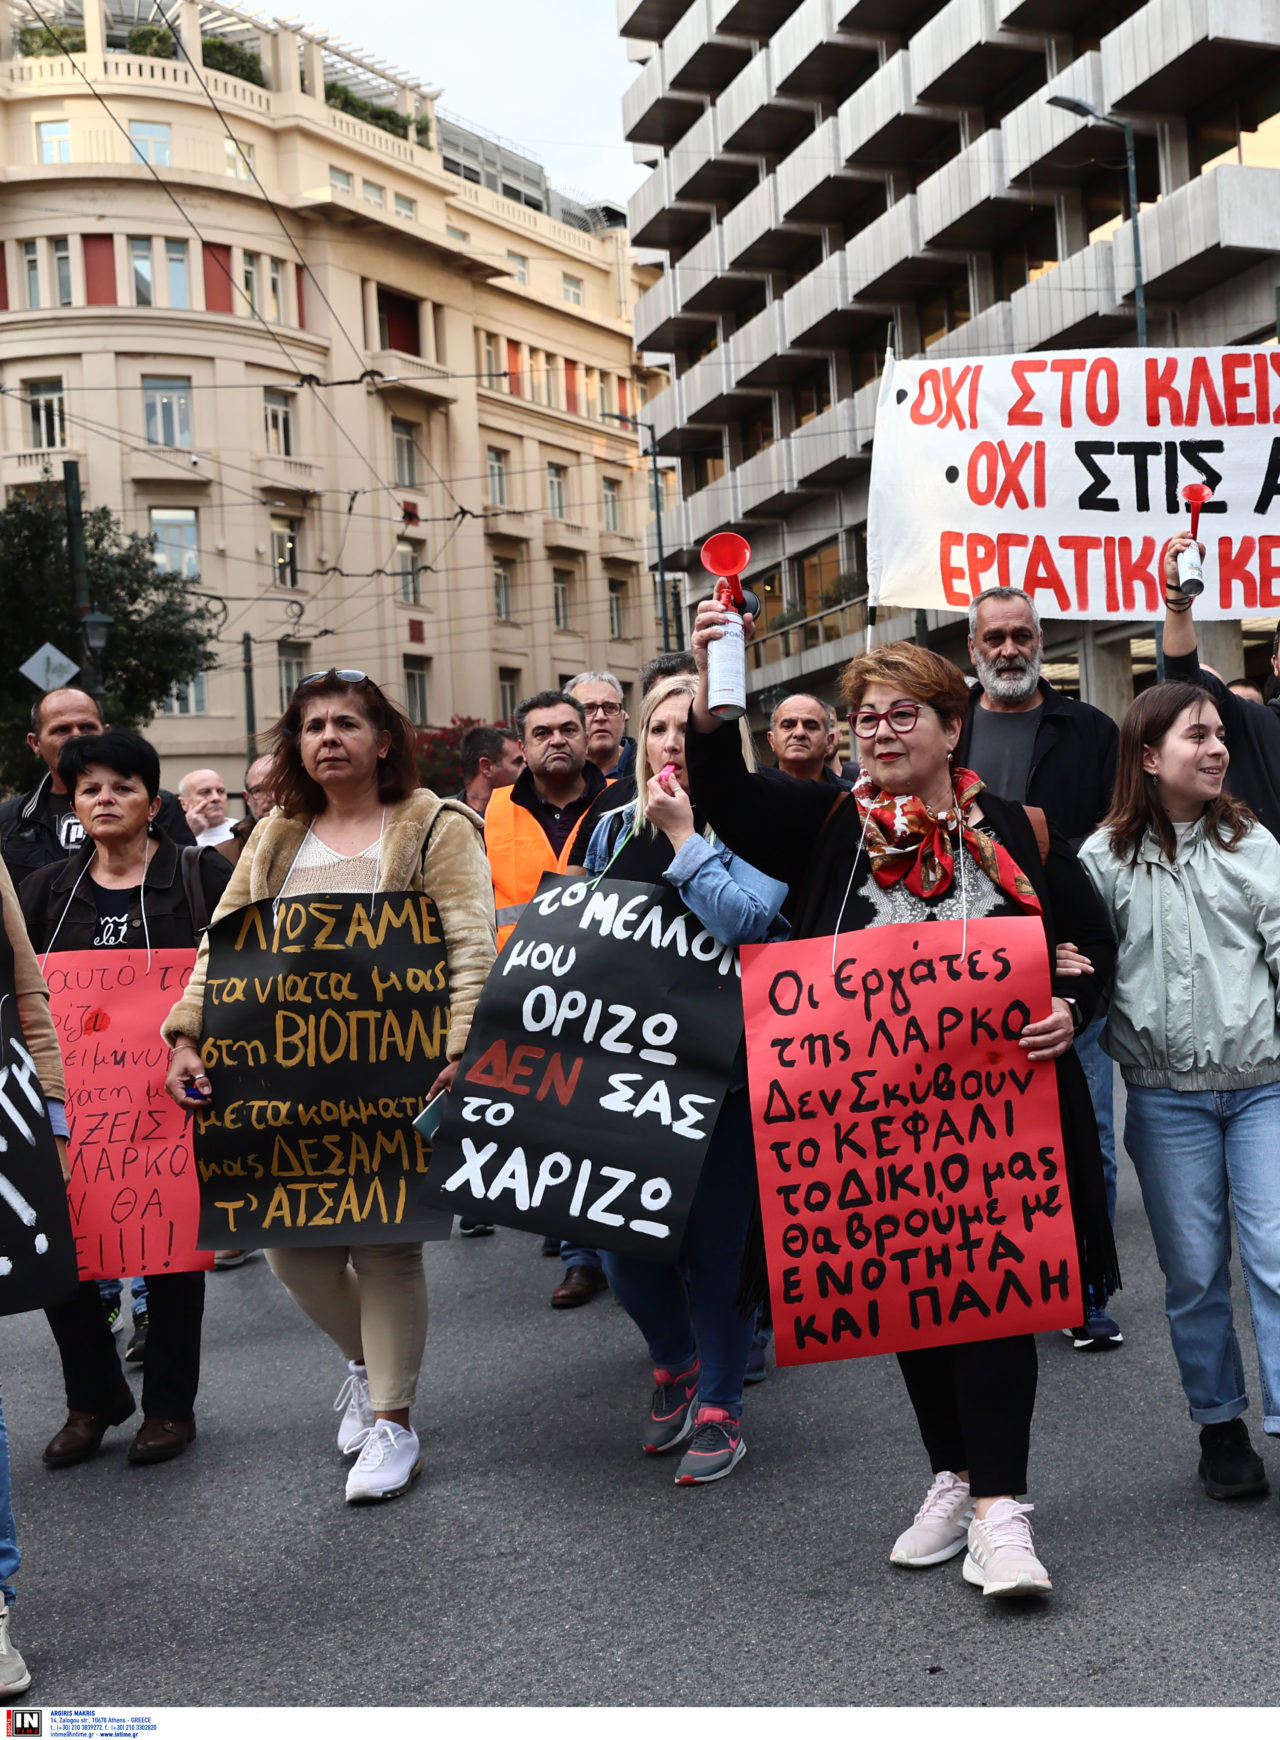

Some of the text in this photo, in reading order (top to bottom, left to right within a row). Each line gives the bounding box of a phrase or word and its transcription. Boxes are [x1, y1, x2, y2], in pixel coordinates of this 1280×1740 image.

[910, 365, 983, 431] ΟΧΙ
[1007, 357, 1120, 428] ΣΤΟ
[967, 439, 1047, 510] ΟΧΙ
[1074, 439, 1228, 514] ΣΤΙΣ
[371, 961, 446, 1002] μας
[502, 939, 577, 977] μου
[768, 969, 819, 1016] Οι
[201, 1037, 267, 1068] στη
[770, 999, 1031, 1068] της ΛΑΡΚΟ
[461, 1096, 515, 1127] το
[464, 1038, 716, 1140] ΔΕΝ ΣΑΣ
[763, 1078, 841, 1125] Δεν
[768, 1100, 1014, 1173] το ΚΕΦΑΛΙ
[70, 1144, 189, 1184] ΛΑΡΚΟ
[983, 1146, 1058, 1198] μας
[111, 1187, 163, 1224] ΘΑ
[783, 1230, 1025, 1305] ΕΝΟΤΗΤΑ
[795, 1259, 1070, 1350] ΚΑΙ ΠΑΛΗ
